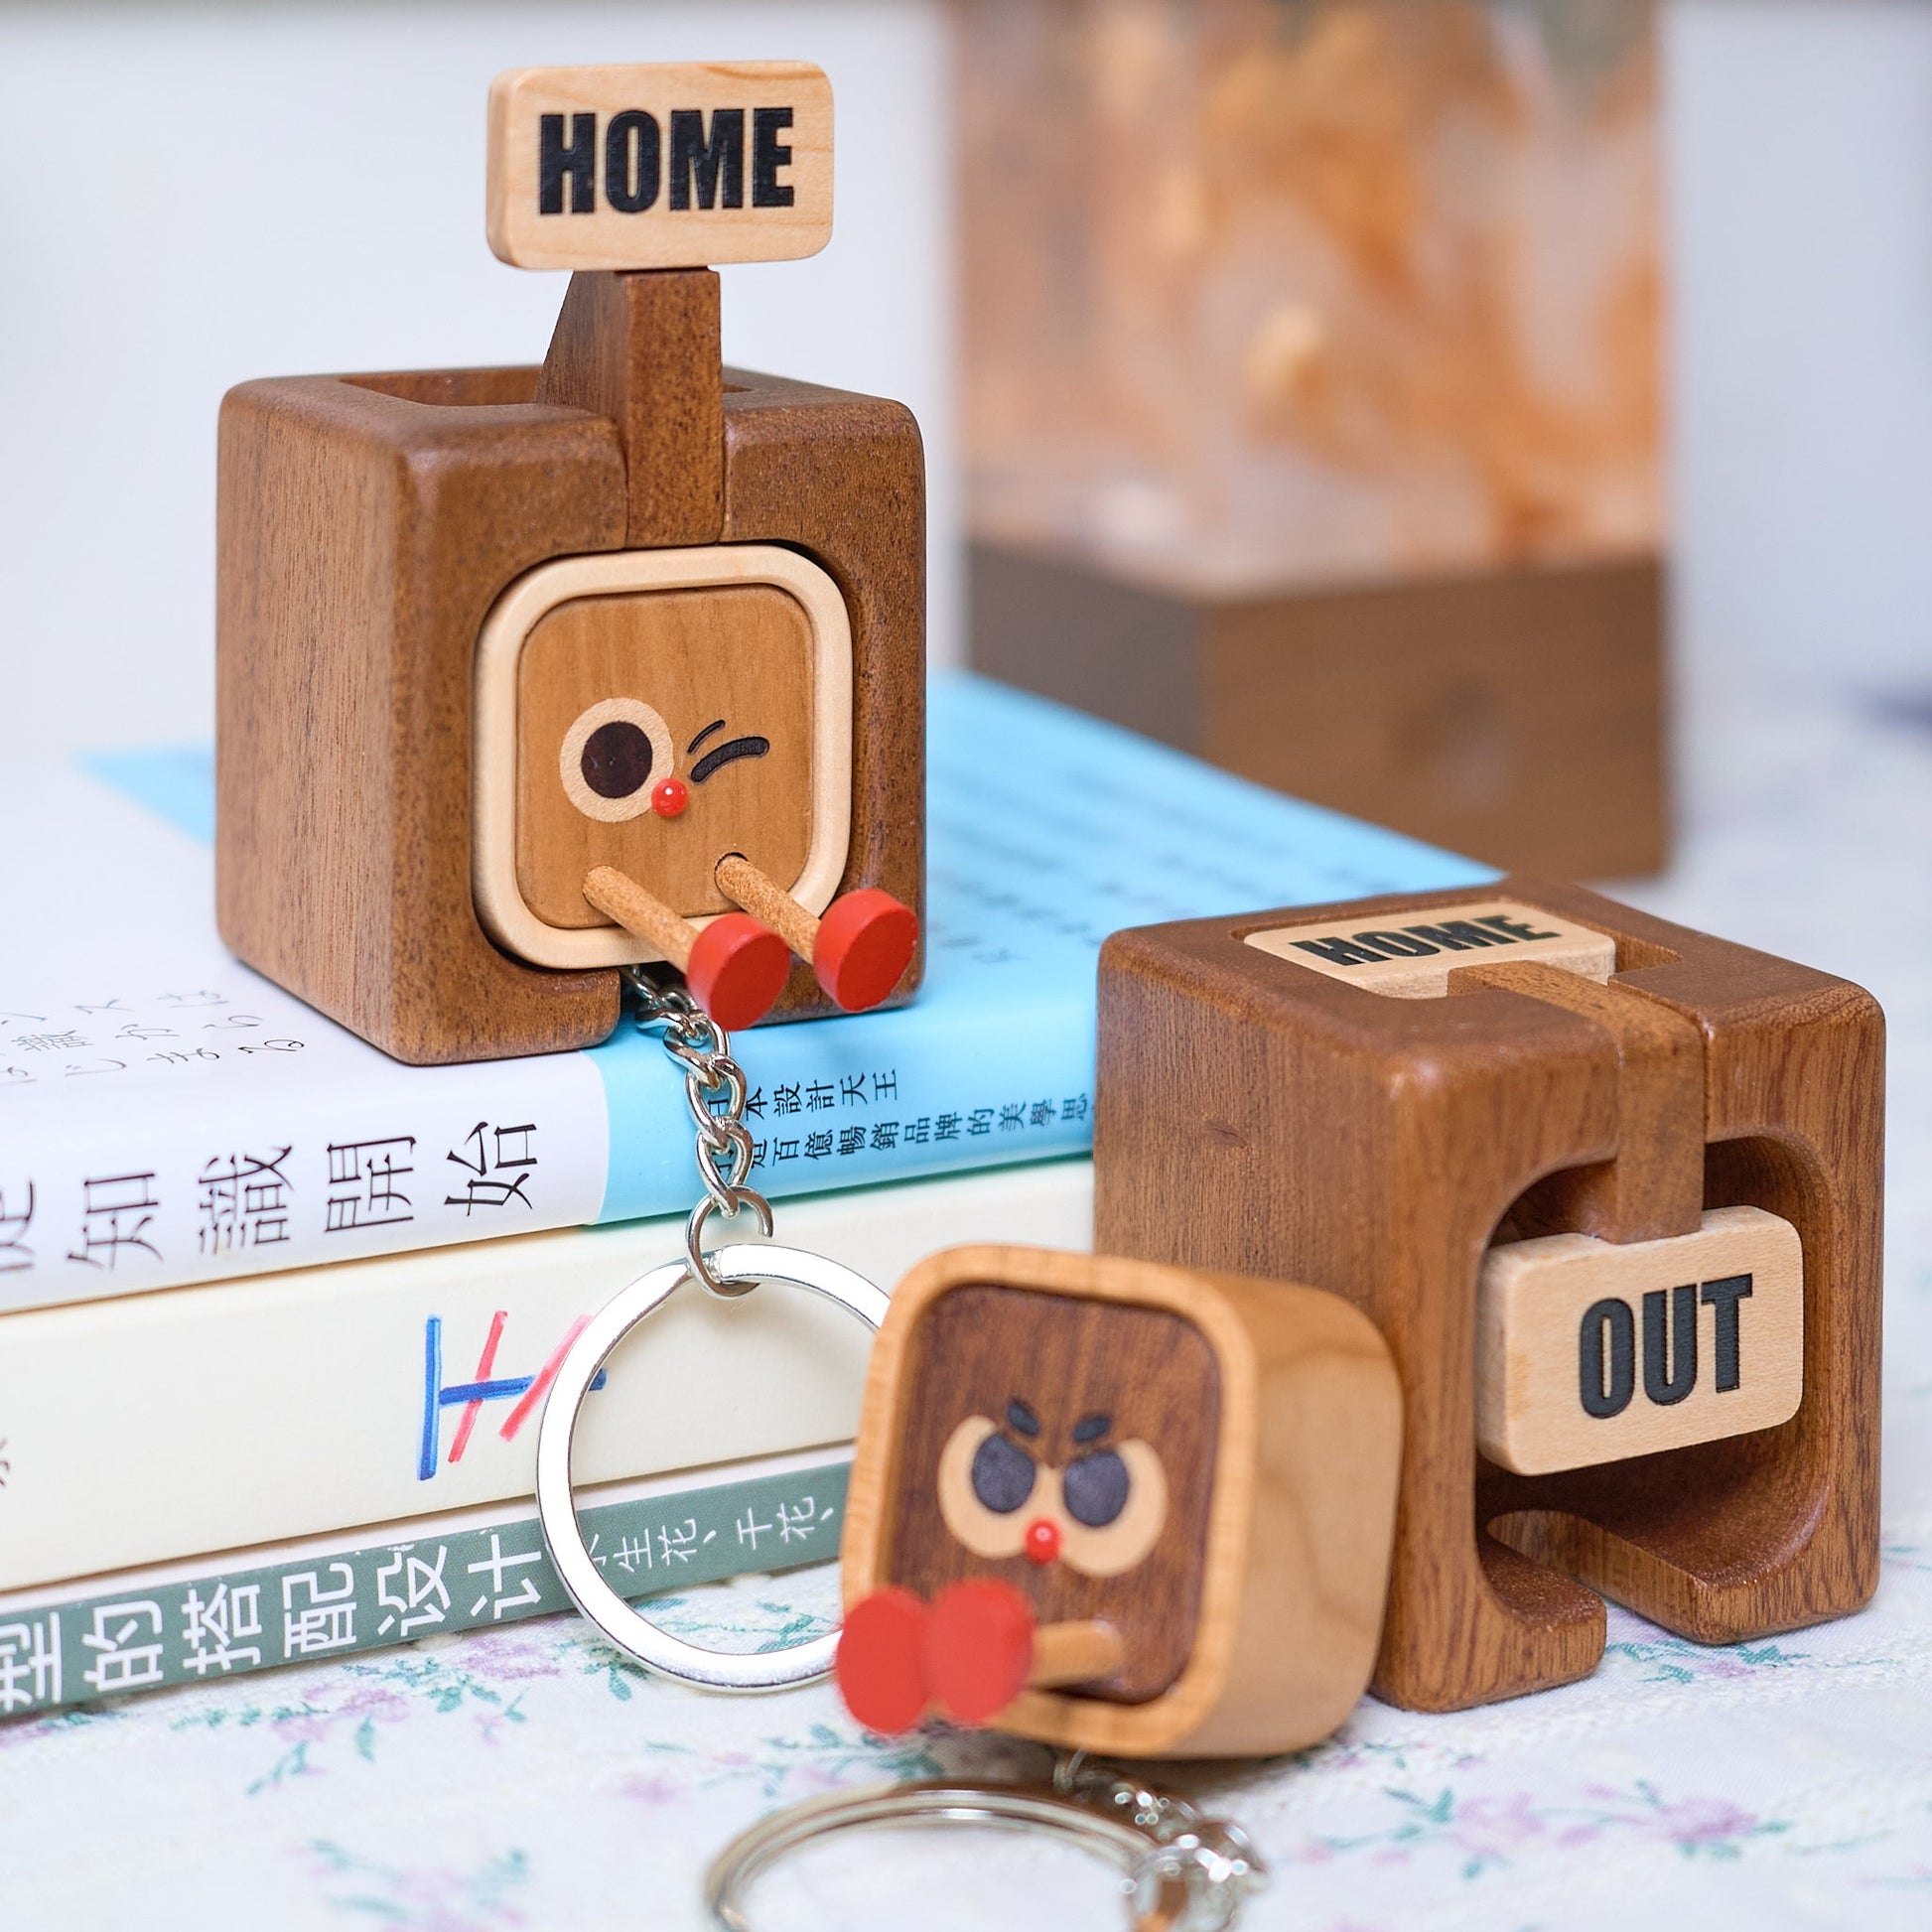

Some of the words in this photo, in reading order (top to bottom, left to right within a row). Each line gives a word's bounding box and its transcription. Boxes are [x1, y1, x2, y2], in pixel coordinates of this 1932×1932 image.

[539, 107, 795, 215] HOME
[1288, 914, 1563, 966] HOME
[1580, 1273, 1753, 1419] OUT
[0, 1533, 543, 1713] 型的搭配设计
